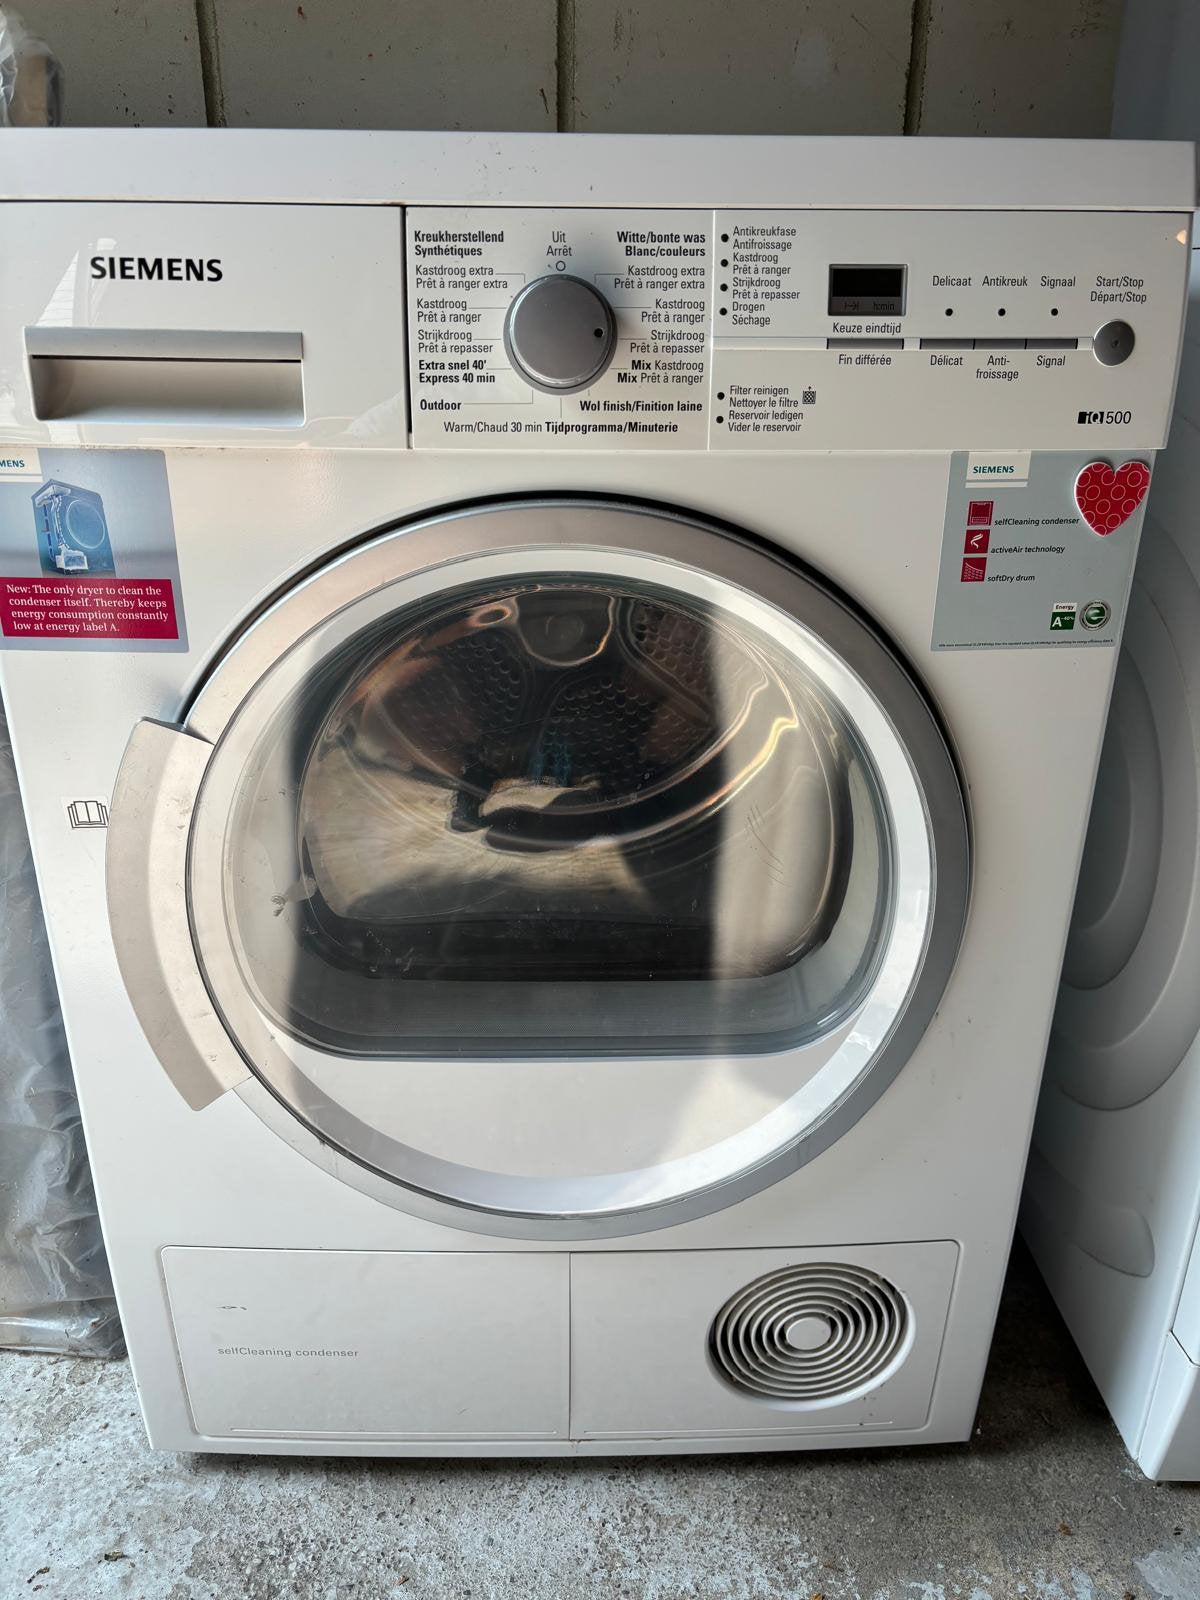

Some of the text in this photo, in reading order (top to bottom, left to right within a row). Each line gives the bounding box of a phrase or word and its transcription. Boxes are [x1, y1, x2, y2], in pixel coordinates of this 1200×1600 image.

[414, 231, 504, 243] Kreukherstellend
[552, 232, 566, 242] Uit
[617, 232, 706, 244] Witte/bonte was
[733, 226, 796, 238] Antikreukfase
[415, 245, 482, 257] Synthétiques
[546, 245, 572, 256] Arrêt
[626, 246, 706, 257] Blanc/couleurs
[733, 239, 792, 252] Antifroissage
[733, 252, 779, 265] Kastdroog
[90, 256, 223, 282] SIEMENS
[416, 265, 494, 277] Kastdroog extra
[628, 266, 705, 278] Kastdroog extra
[733, 264, 791, 277] Prêt à ranger
[416, 278, 508, 291] Prêt à ranger extra
[614, 278, 705, 292] Prêt à ranger extra
[733, 277, 780, 290] Strijkdroog
[932, 275, 971, 288] Delicaat
[982, 275, 1027, 288] Antikreuk
[1041, 275, 1076, 289] Signaal
[1096, 276, 1144, 290] Start/Stop
[733, 289, 800, 301] Prêt à repasser
[1091, 290, 1146, 305] Départ/Stop
[417, 299, 467, 311] Kastdroog
[655, 299, 705, 312] Kastdroog
[732, 302, 765, 314] Drogen
[418, 312, 482, 325] Prêt à ranger
[642, 312, 705, 326] Prêt à ranger
[732, 314, 771, 327] Séchage
[833, 323, 901, 335] Keuze eindtijd
[418, 330, 472, 342] Strijkdroog
[651, 330, 704, 342] Strijkdroog
[418, 342, 493, 356] Prêt à repasser
[630, 342, 704, 356] Prêt à repasser
[419, 360, 486, 370] Extra snel 40'
[839, 354, 891, 366] Fin différée
[930, 354, 963, 367] Délicat
[988, 355, 1010, 366] Anti-
[1037, 355, 1066, 369] Signal
[632, 360, 704, 373] Mix Kastdroog
[419, 373, 495, 386] Express 40 min
[618, 372, 703, 386] Mix Prêt à ranger
[976, 368, 1018, 381] froissage
[730, 385, 789, 398] Filter reinigen
[420, 400, 461, 411] Outdoor
[580, 401, 702, 412] Wol finish/Finition laine
[730, 397, 798, 409] Nettoyer le filtre
[729, 410, 804, 423] Reservoir ledigen
[444, 422, 678, 435] Warm/Chaud 30 min Tijdprogramma/Minuterie
[728, 422, 750, 432] Vider
[753, 422, 760, 432] le
[973, 466, 1014, 474] SIEMENS
[994, 517, 1079, 527] selfCleaning condenser
[991, 546, 1065, 554] activeAir technology
[987, 574, 1035, 583] softDry drum
[6, 585, 162, 596] New: The only dryer to clean the
[9, 597, 167, 609] condenser itself. Thereby keeps
[12, 610, 168, 622] energy consumption constantly
[14, 622, 31, 630] low
[46, 623, 80, 633] energy
[83, 622, 107, 631] label
[110, 623, 119, 632] A.
[217, 1346, 359, 1358] selfCleaning condenser
